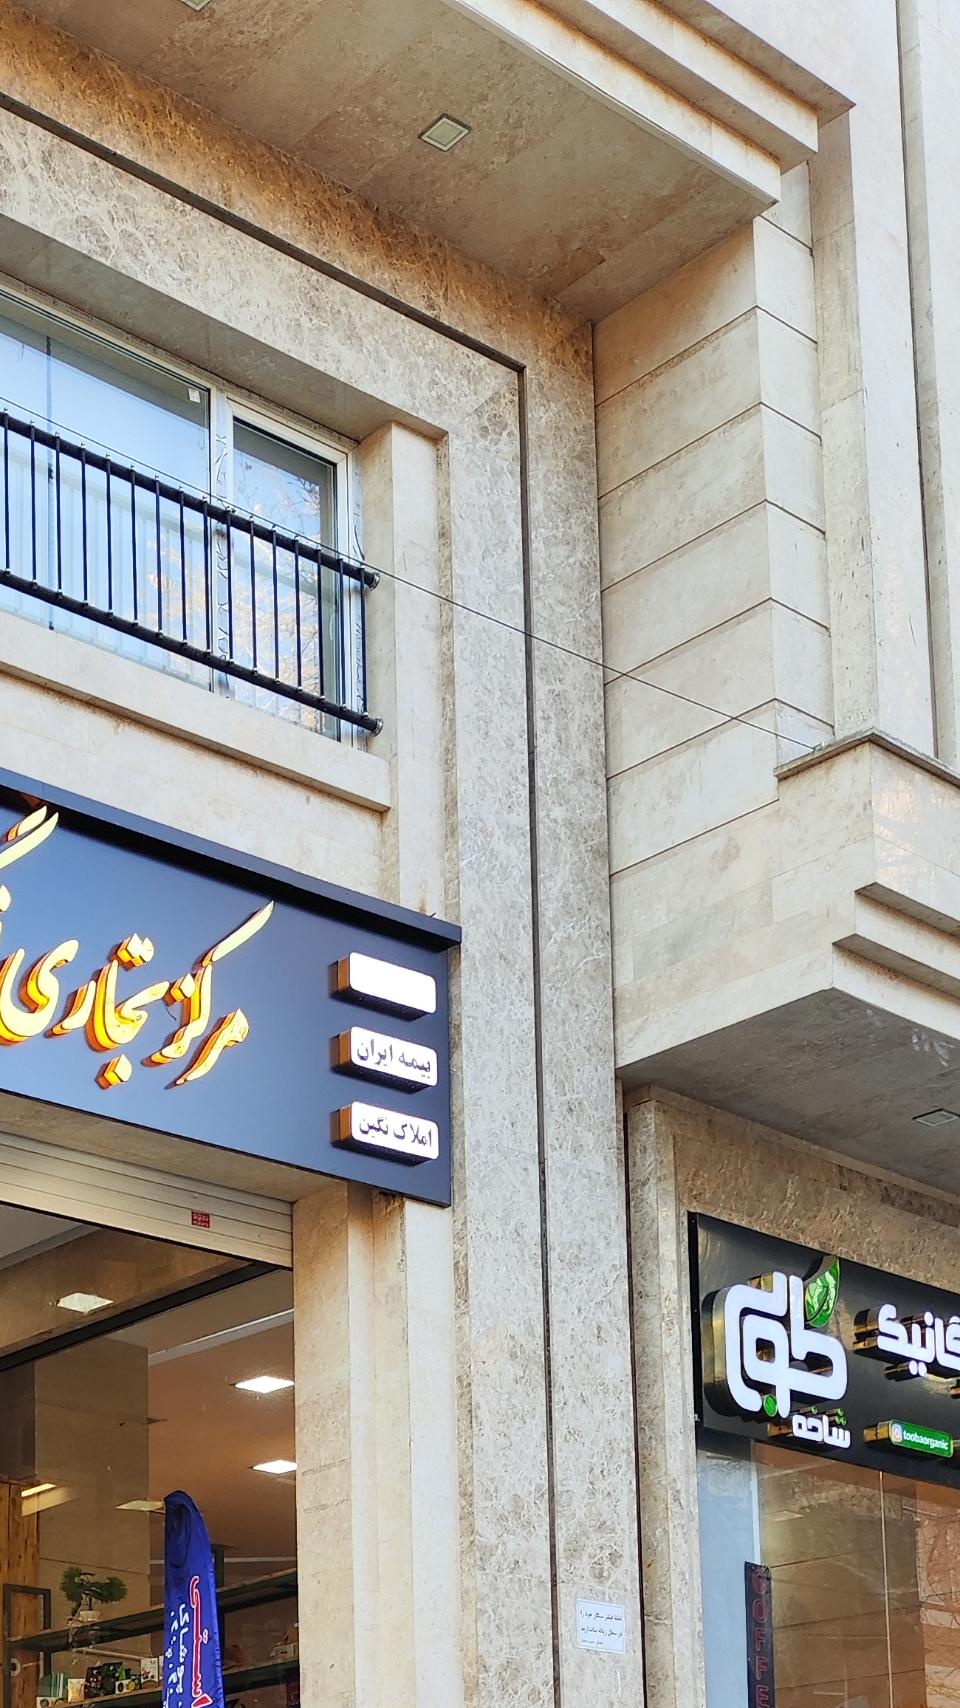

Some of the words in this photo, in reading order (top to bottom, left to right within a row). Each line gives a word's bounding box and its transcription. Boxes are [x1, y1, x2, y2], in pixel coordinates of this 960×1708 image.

[143, 900, 274, 1086] مرکز
[356, 1037, 394, 1067] ایران
[398, 1051, 432, 1079] بیمه
[359, 1116, 390, 1138] نگین
[393, 1121, 433, 1147] املاک
[175, 1603, 190, 1694] پوشاک
